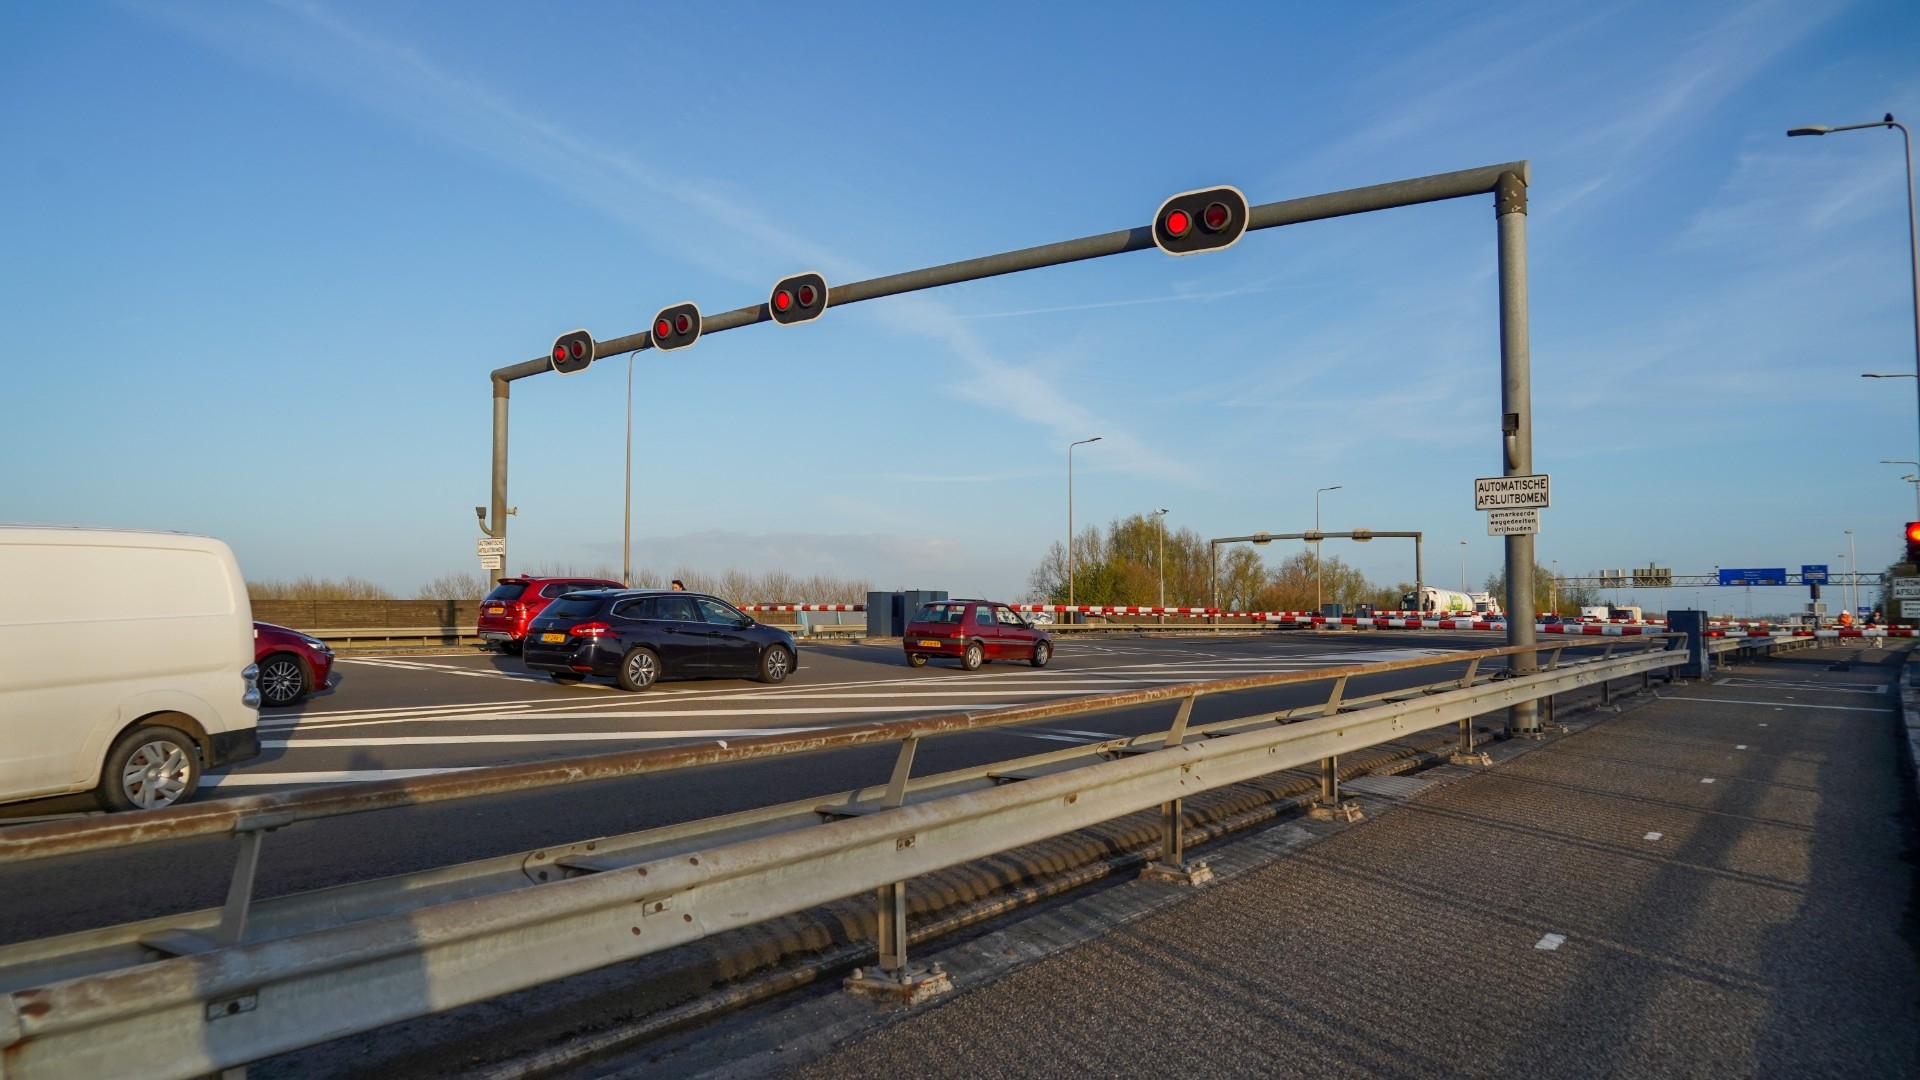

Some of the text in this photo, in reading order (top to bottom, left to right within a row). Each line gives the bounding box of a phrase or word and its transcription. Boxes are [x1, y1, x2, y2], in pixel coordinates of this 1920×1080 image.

[1478, 479, 1546, 492] AUTOMATISCHE
[1478, 492, 1546, 505] AFSLUITBOMEN
[1490, 511, 1535, 519] gemarkeerde
[1490, 518, 1536, 526] weggedeelten
